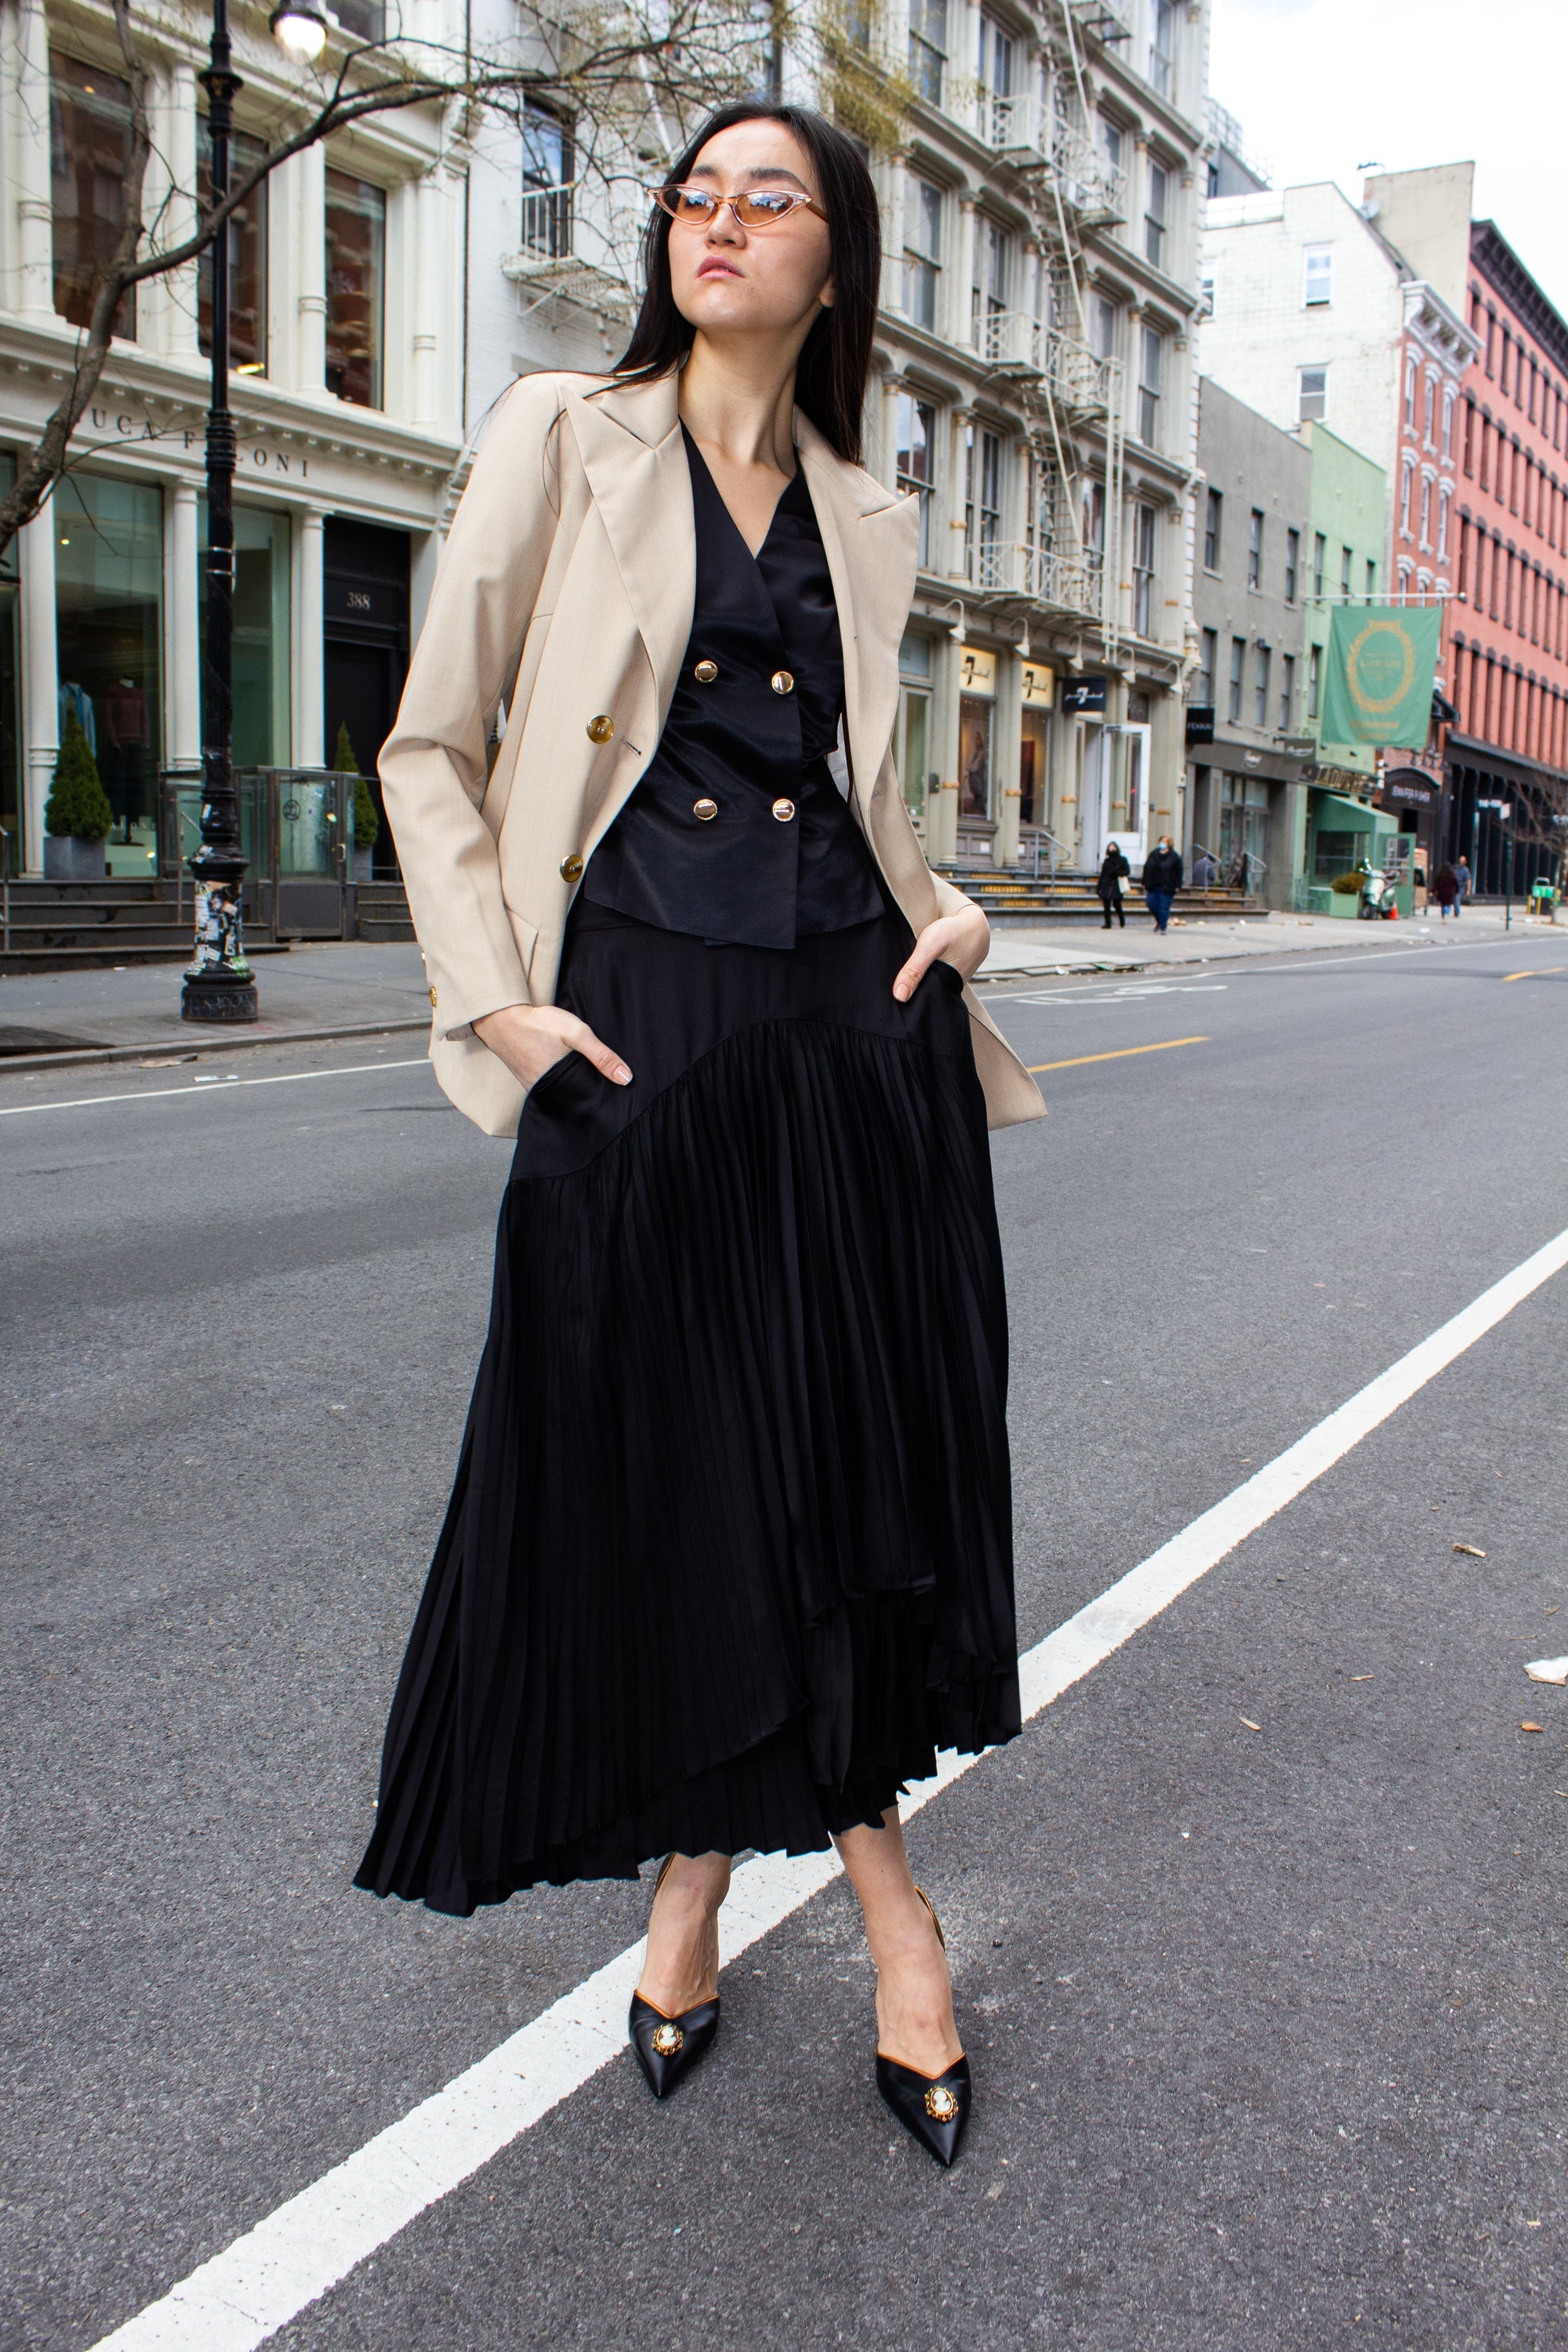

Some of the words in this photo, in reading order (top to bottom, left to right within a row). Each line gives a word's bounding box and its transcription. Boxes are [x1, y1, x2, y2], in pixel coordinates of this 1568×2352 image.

[91, 408, 157, 441] UCA
[183, 430, 308, 477] FONI
[347, 591, 371, 610] 388
